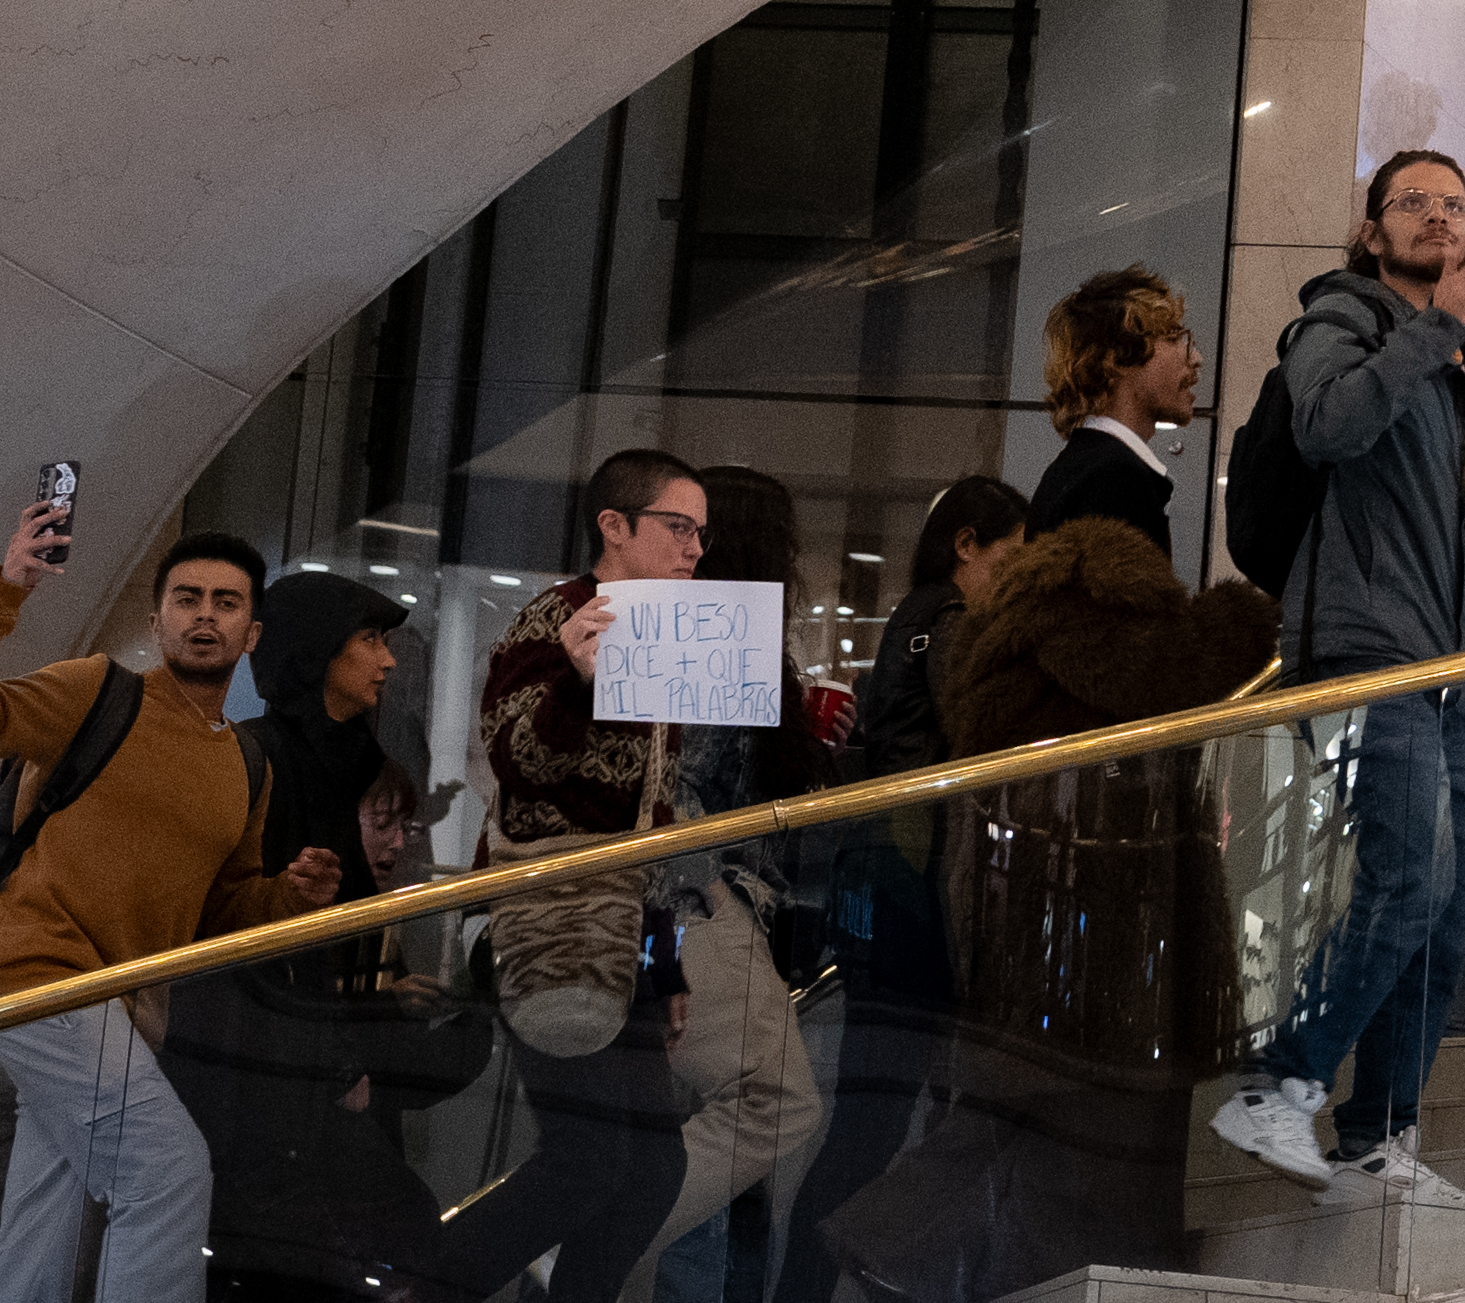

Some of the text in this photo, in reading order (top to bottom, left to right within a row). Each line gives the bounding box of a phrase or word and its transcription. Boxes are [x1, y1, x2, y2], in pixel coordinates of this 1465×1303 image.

[630, 601, 749, 642] UN BESO
[603, 644, 664, 679] DICE
[707, 648, 767, 687] QUE
[601, 679, 654, 718] MIL
[664, 677, 778, 726] PALABRAS
